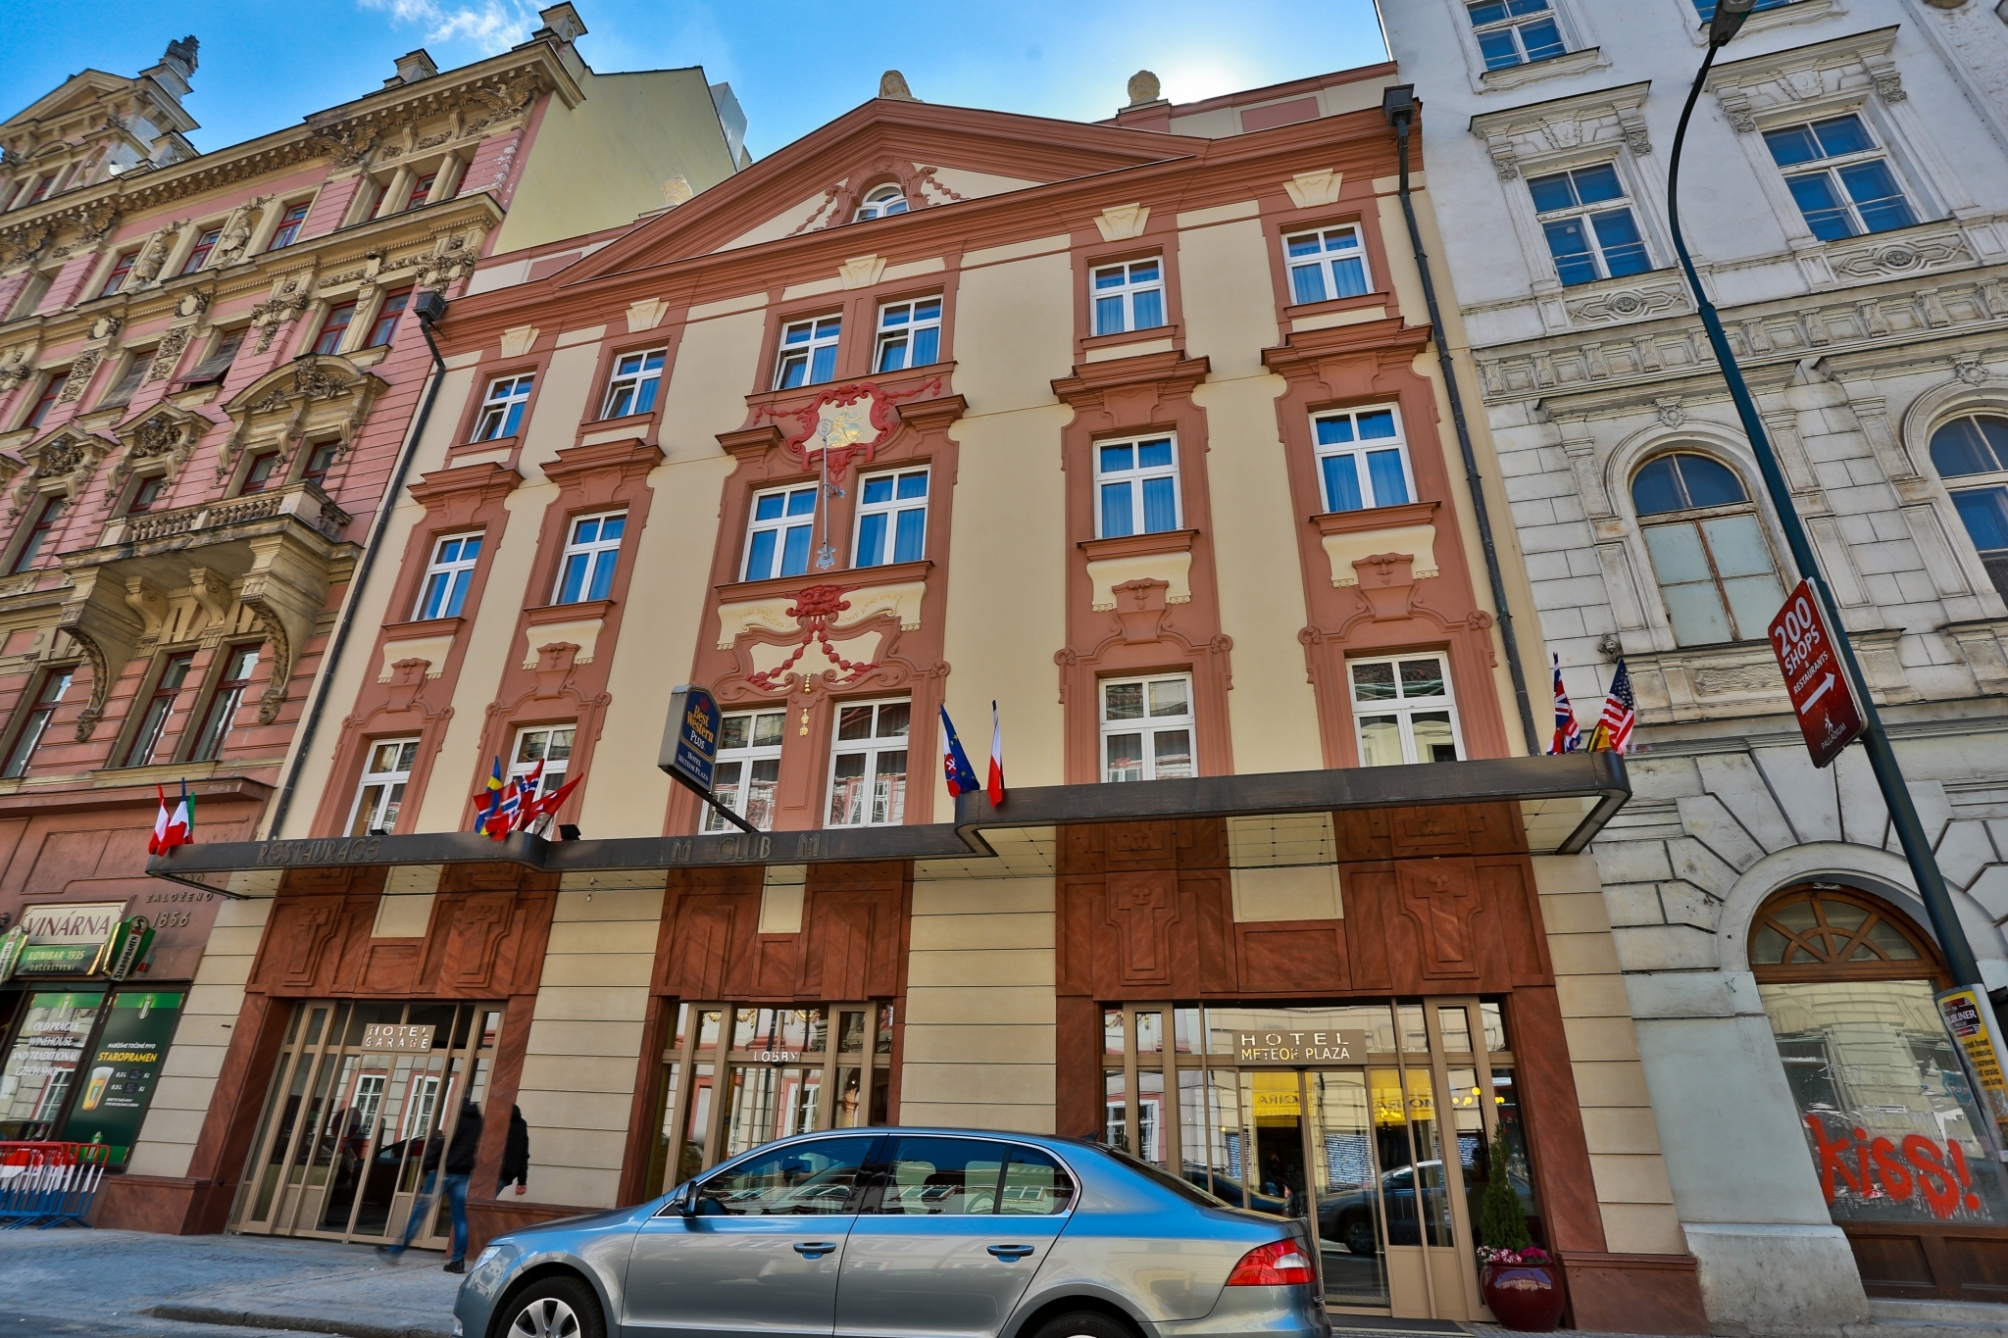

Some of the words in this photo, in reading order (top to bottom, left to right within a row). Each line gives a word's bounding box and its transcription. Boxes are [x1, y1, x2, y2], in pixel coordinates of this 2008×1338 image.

[1774, 596, 1812, 658] 200
[1784, 624, 1820, 676] SHOPS
[1804, 659, 1810, 669] &
[1793, 651, 1829, 695] RESTAURANTS
[693, 704, 710, 727] Best
[687, 710, 714, 743] Western
[1820, 722, 1847, 750] PALLADIUM
[257, 838, 382, 866] RESTAURACE
[671, 838, 692, 862] M
[718, 834, 771, 861] CLUB
[797, 831, 820, 859] M
[145, 891, 214, 904] ZALOŽENO
[26, 910, 111, 937] VINÁRNA
[152, 911, 192, 928] 1856
[67, 950, 85, 961] 1935
[33, 1021, 50, 1031] OLD
[50, 1021, 80, 1031] PRAGUE
[368, 1026, 429, 1037] HOTEL
[28, 1036, 74, 1046] WINEHOUSE
[365, 1036, 429, 1049] GARAGE
[1241, 1032, 1350, 1046] HOTEL
[11, 1051, 29, 1061] AND
[29, 1051, 78, 1061] TRADITIONAL
[97, 1051, 158, 1062] STAROPRAMEN
[1241, 1047, 1299, 1061] METEOR
[1305, 1047, 1350, 1060] PLAZA
[15, 1066, 40, 1076] CZECH
